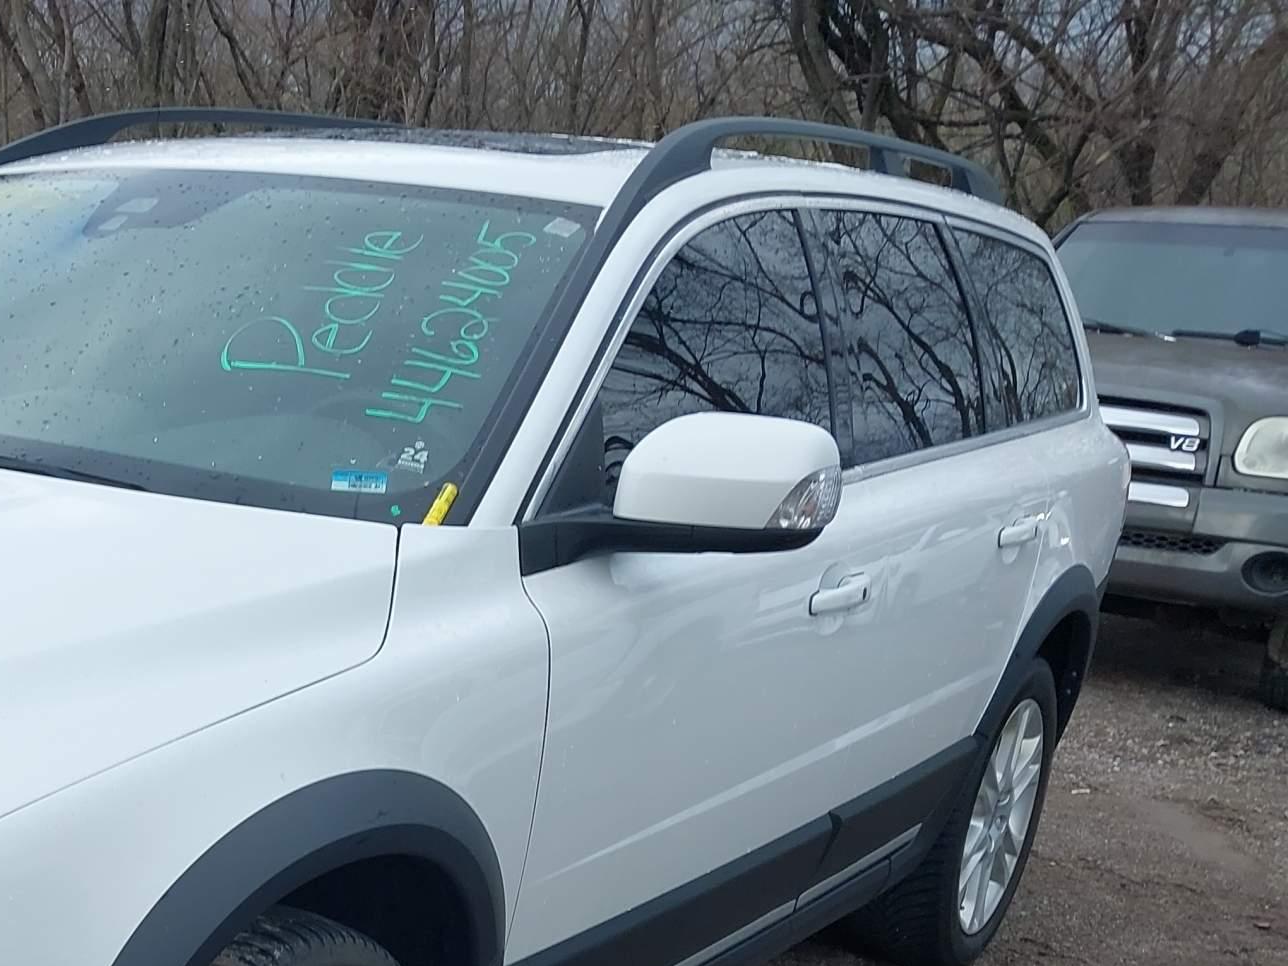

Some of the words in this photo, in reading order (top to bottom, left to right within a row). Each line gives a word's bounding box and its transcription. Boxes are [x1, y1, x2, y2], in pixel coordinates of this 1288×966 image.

[220, 230, 424, 379] Peddle
[364, 219, 537, 424] 44624005
[1170, 435, 1201, 452] V8
